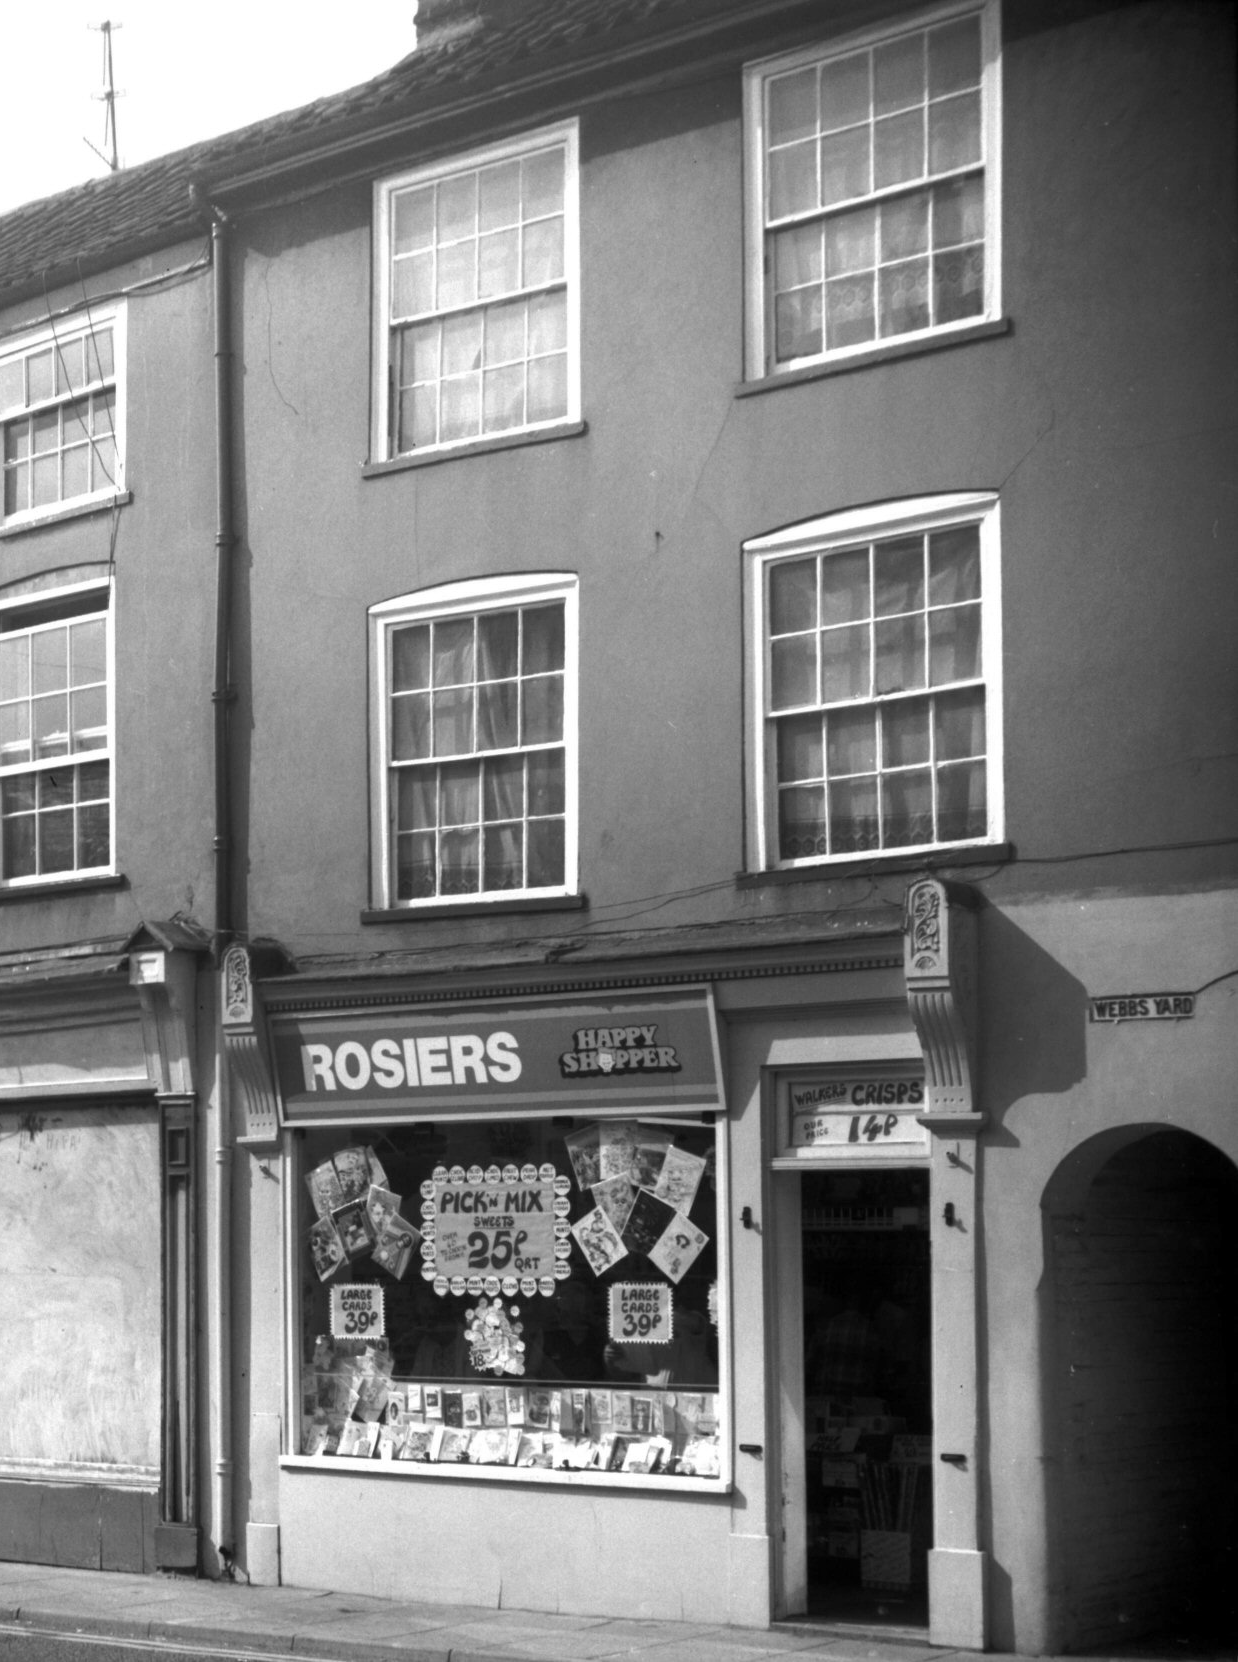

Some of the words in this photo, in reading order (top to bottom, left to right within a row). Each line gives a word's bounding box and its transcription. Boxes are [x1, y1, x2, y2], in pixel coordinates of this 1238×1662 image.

[1095, 1000, 1150, 1018] WEBBS
[1154, 997, 1193, 1015] YARD
[574, 1025, 658, 1050] HAPPY
[301, 1031, 522, 1092] ROSIERS
[794, 1083, 847, 1106] WALKERS
[851, 1081, 924, 1107] CRISPS
[804, 1119, 823, 1130] OUR
[805, 1127, 829, 1140] PRICE
[440, 1191, 487, 1214] PICK
[504, 1190, 543, 1213] MIX
[474, 1216, 514, 1227] SWEETS
[442, 1232, 458, 1241] OVER
[514, 1257, 540, 1273] QRT
[340, 1289, 372, 1300] LARGE
[621, 1289, 660, 1301] LARGE
[342, 1301, 372, 1311] CARDS
[621, 1302, 660, 1313] CARDS
